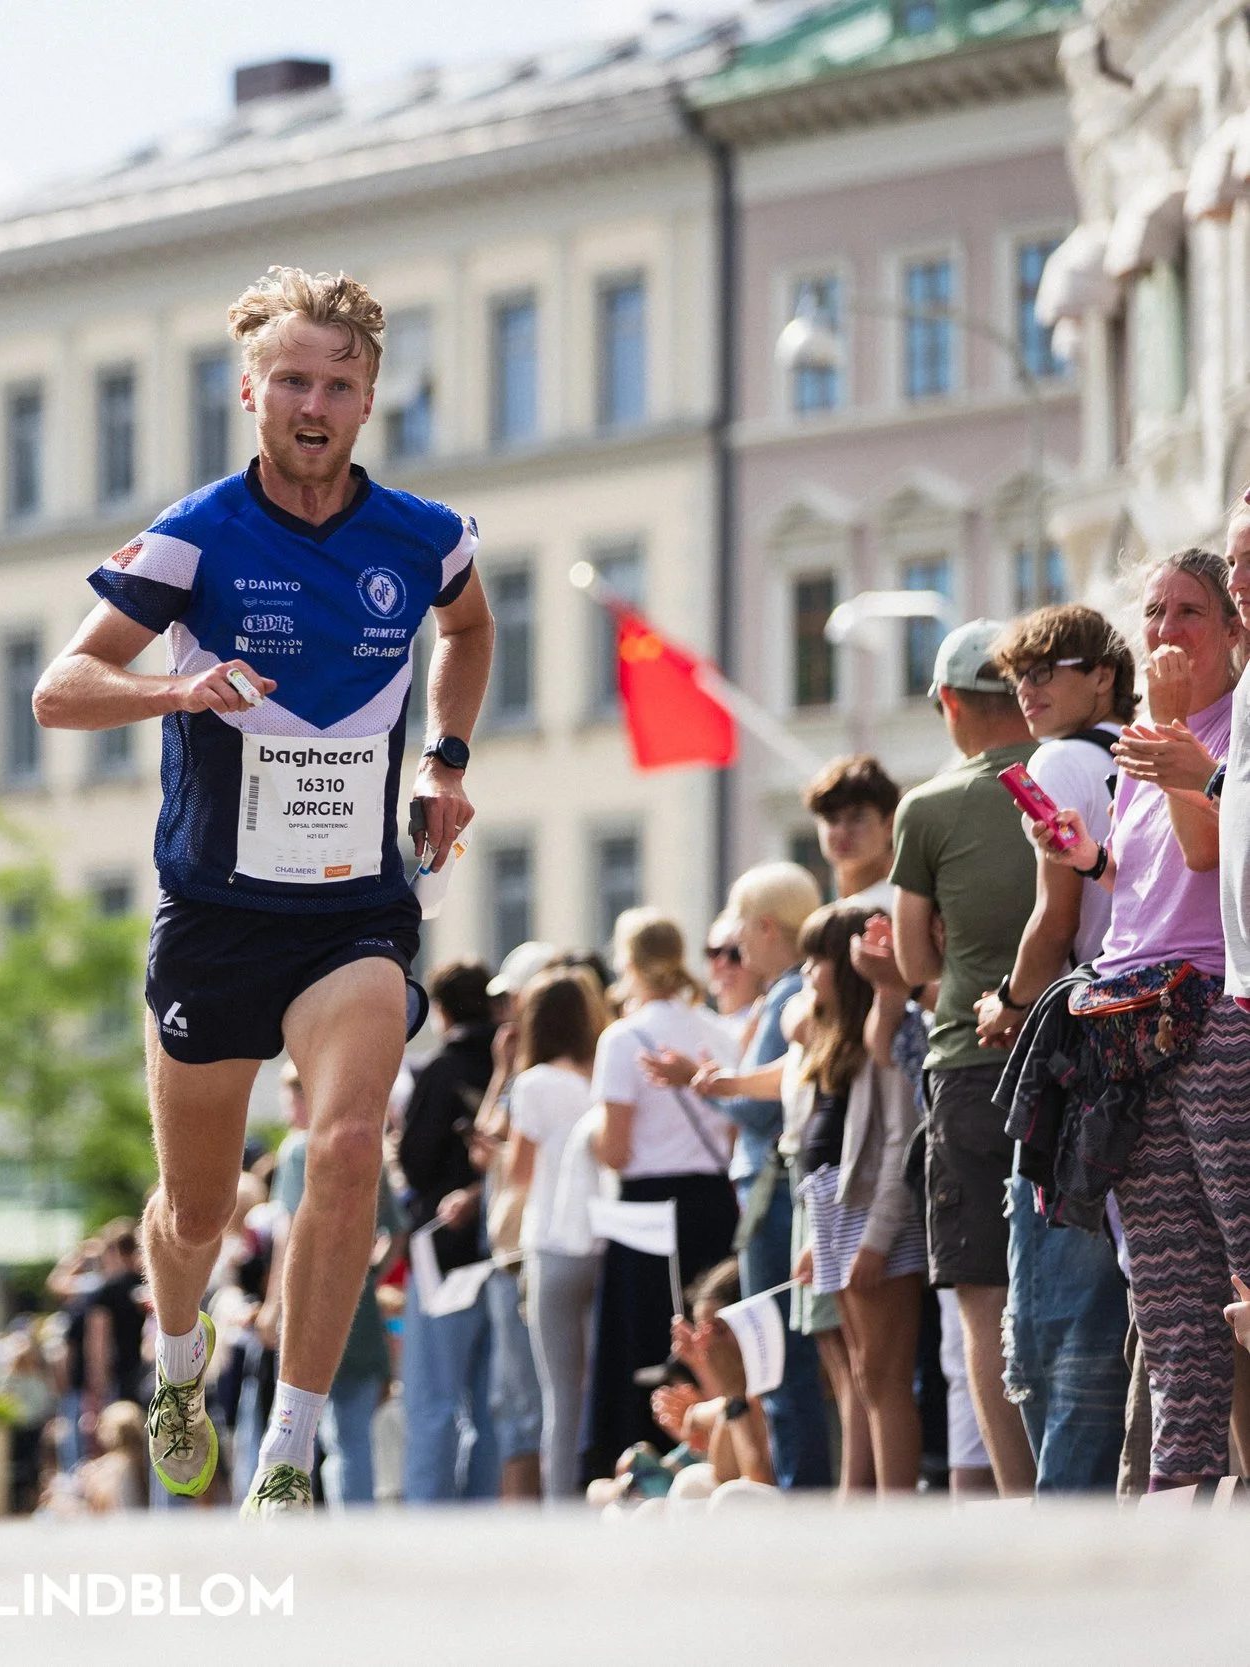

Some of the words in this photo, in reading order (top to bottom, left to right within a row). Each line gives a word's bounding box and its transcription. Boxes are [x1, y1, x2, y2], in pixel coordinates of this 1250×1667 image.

[356, 565, 378, 589] OPPSAL
[248, 579, 301, 592] DAIMYO
[363, 627, 407, 639] TRIMTEX
[353, 643, 407, 657] LÖPLABBET
[259, 745, 374, 768] bagheera
[296, 778, 345, 793] 16310
[282, 801, 354, 817] JØRGEN
[274, 865, 317, 875] CHALMERS
[162, 1025, 189, 1038] surpas
